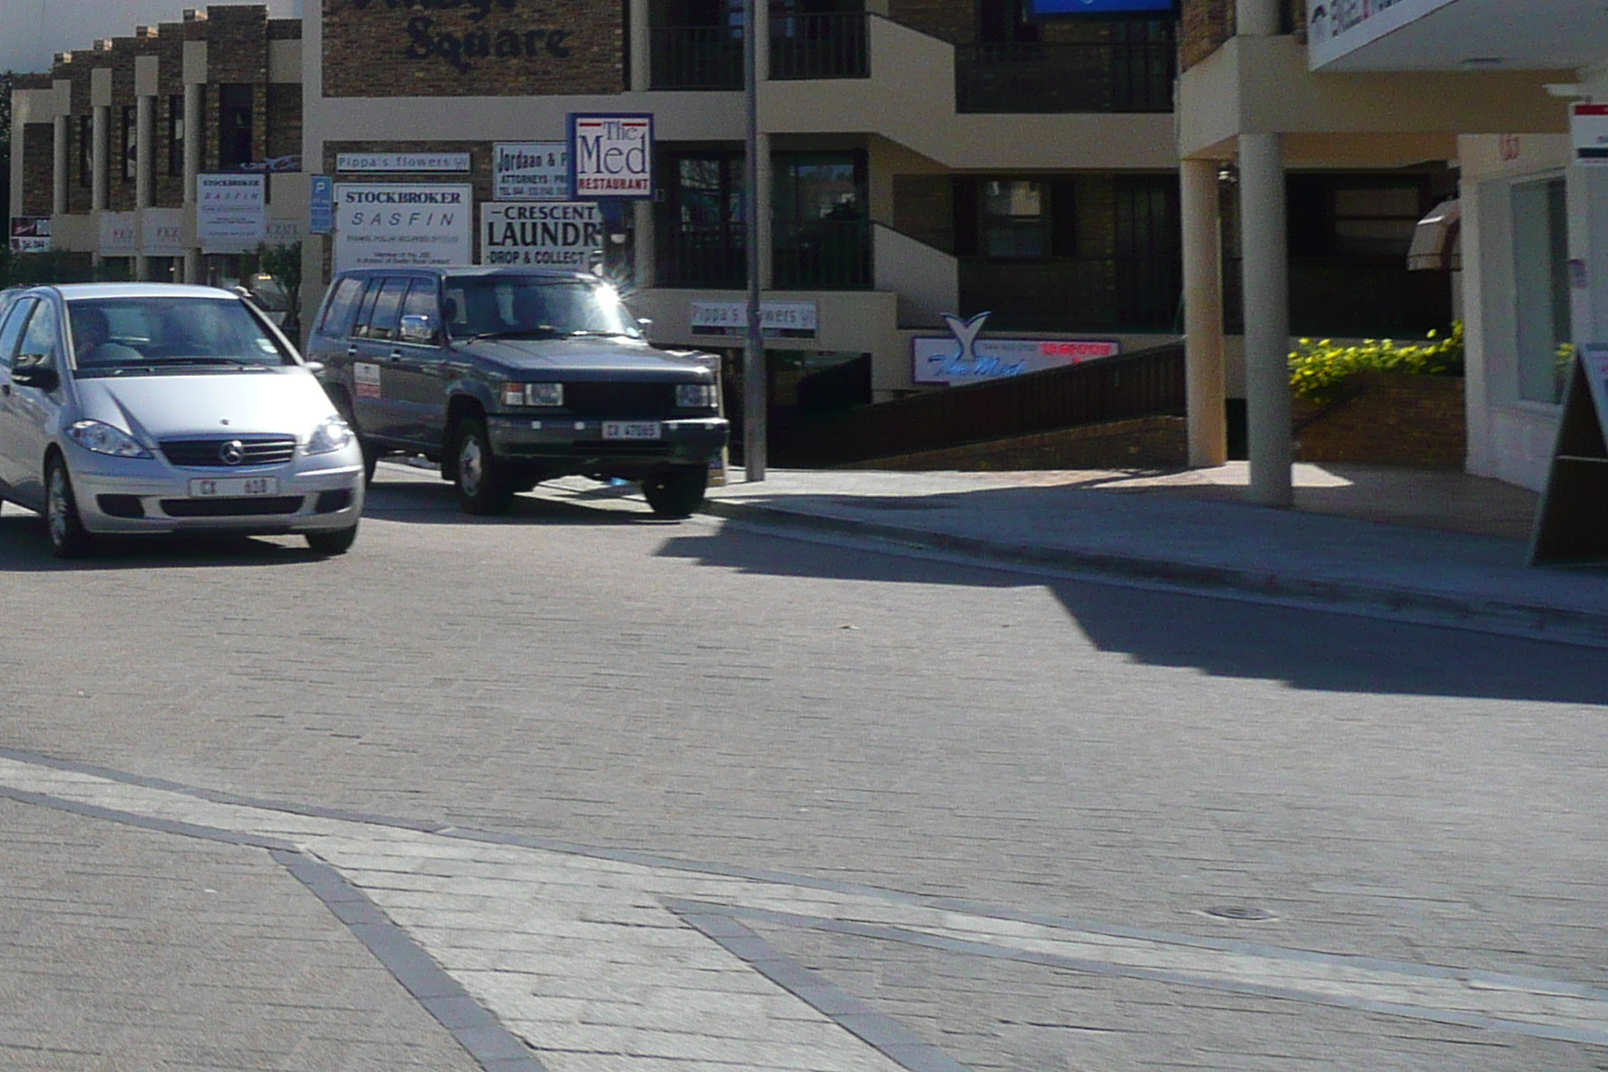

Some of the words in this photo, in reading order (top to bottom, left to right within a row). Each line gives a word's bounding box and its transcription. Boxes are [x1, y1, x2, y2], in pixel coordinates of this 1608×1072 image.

[406, 15, 570, 74] Square
[603, 120, 638, 141] The
[496, 147, 542, 173] Jordaan
[547, 151, 556, 167] &
[578, 132, 648, 175] Med
[338, 156, 389, 168] Pippa's
[396, 155, 449, 167] flowers
[501, 174, 548, 184] ATTORNEYS
[578, 178, 649, 191] RESTAURANT
[345, 191, 462, 204] STOCKBROKER
[351, 211, 454, 226] SASFIN
[523, 251, 531, 264] &
[534, 251, 585, 264] COLLECT
[972, 355, 1027, 376] Med
